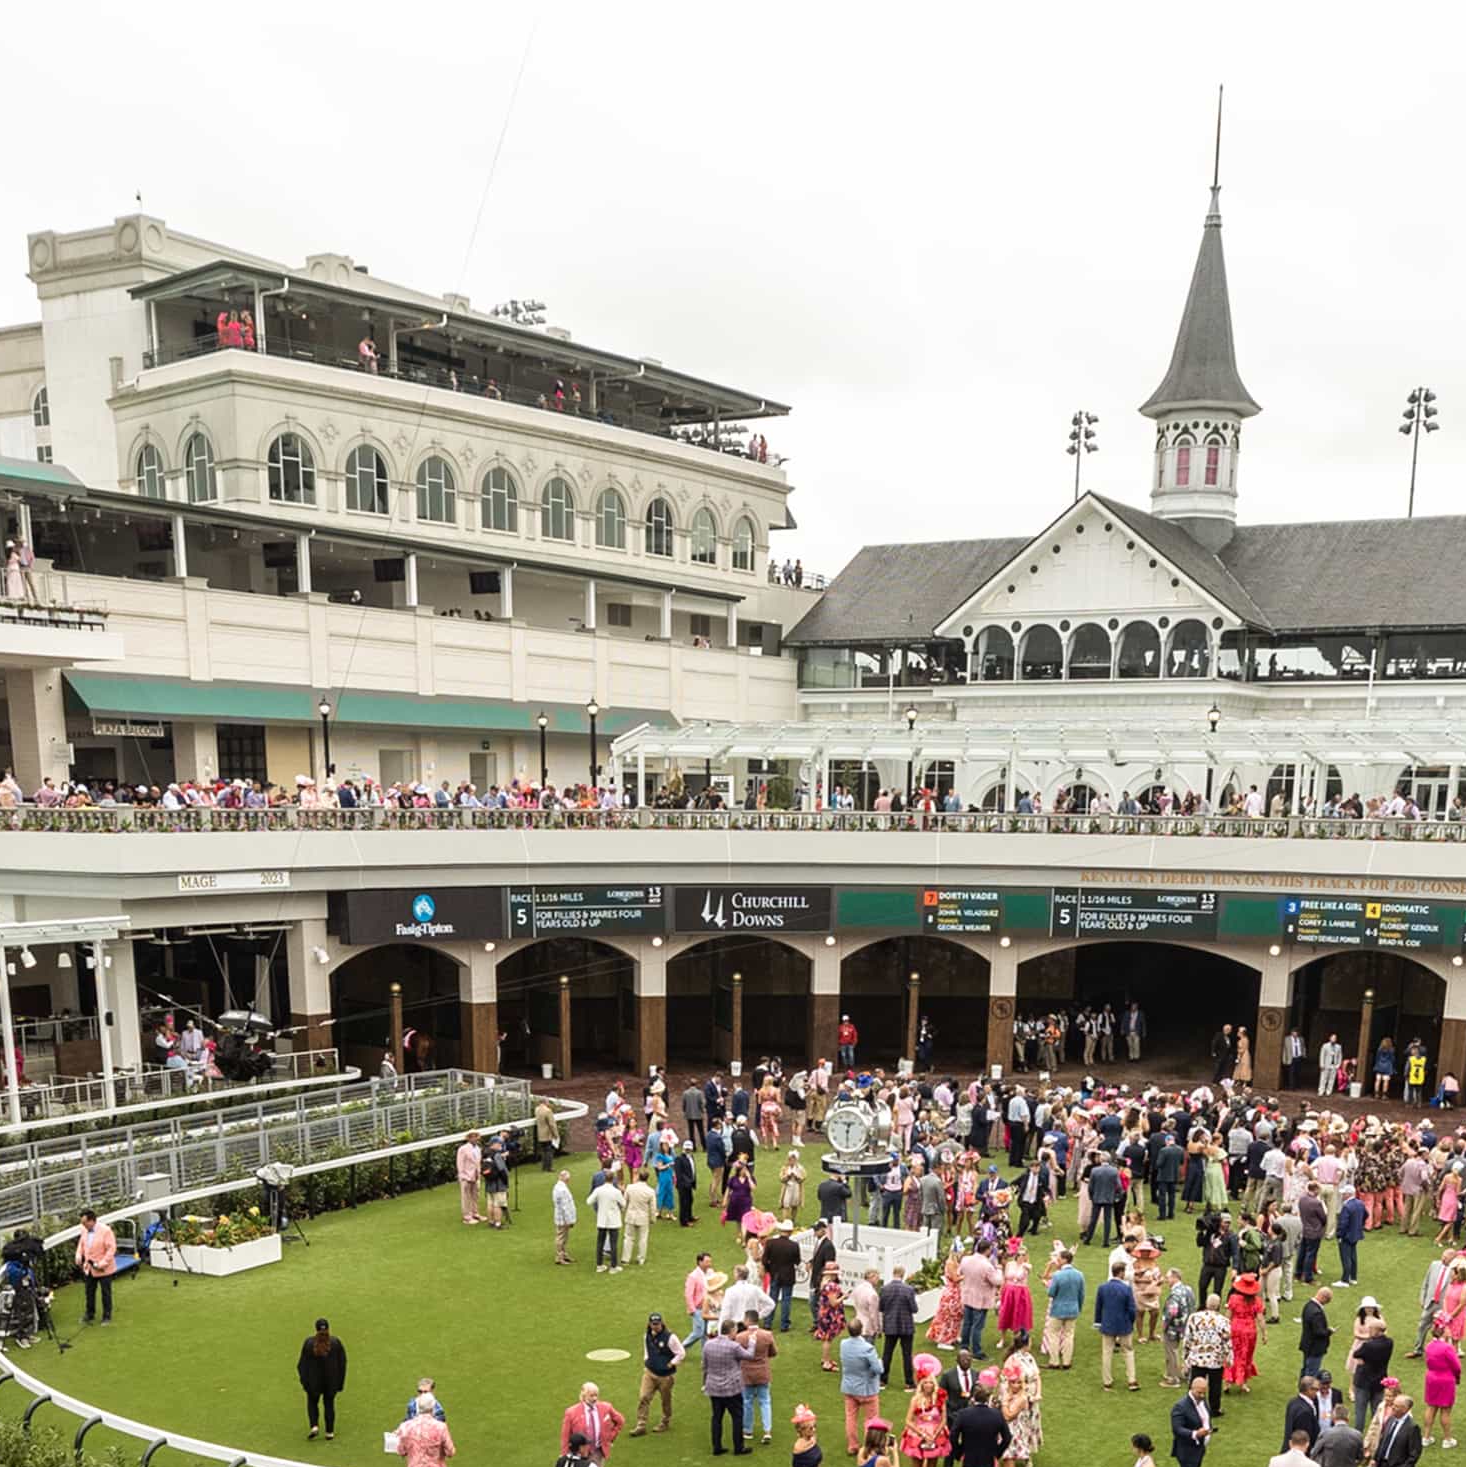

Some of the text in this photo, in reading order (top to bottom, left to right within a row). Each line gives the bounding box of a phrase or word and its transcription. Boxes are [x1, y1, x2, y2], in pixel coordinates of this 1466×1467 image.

[181, 875, 217, 888] MAGE
[260, 872, 285, 885] 2023
[1082, 869, 1155, 884] KENTUCKY
[1160, 872, 1206, 886] DERBY
[1212, 873, 1240, 887] RUN
[1244, 874, 1265, 887] ON
[1269, 875, 1303, 888] THIS
[1308, 877, 1356, 890] TRACK
[1359, 878, 1390, 891] FOR
[1394, 880, 1416, 892] 149
[559, 892, 584, 902] MILES
[648, 886, 661, 898] 13
[511, 894, 532, 903] RACE
[732, 892, 810, 909] CHURCHILL
[926, 894, 934, 903] 7
[1055, 894, 1077, 904] RACE
[1107, 895, 1132, 905] MILES
[1201, 893, 1215, 904] 13
[1288, 902, 1296, 913] 3
[1300, 901, 1319, 910] FREE
[1370, 905, 1378, 915] 4
[1381, 904, 1430, 914] IDIOMATIC
[516, 908, 527, 925] 5
[536, 911, 553, 920] FOR
[554, 910, 581, 920] FILLIES
[590, 909, 618, 919] MARES
[619, 909, 642, 918] FOUR
[732, 911, 784, 927] DOWNS
[1059, 908, 1071, 924] 5
[1080, 912, 1098, 920] FOR
[1099, 912, 1129, 922] FILLIES
[1137, 914, 1167, 923] MARES
[1168, 915, 1193, 924] FOUR
[536, 919, 561, 928] YEARS
[561, 919, 580, 928] OLD
[588, 918, 601, 927] UP
[1080, 920, 1106, 930] YEARS
[1107, 921, 1126, 930] OLD
[1136, 921, 1149, 930] UP
